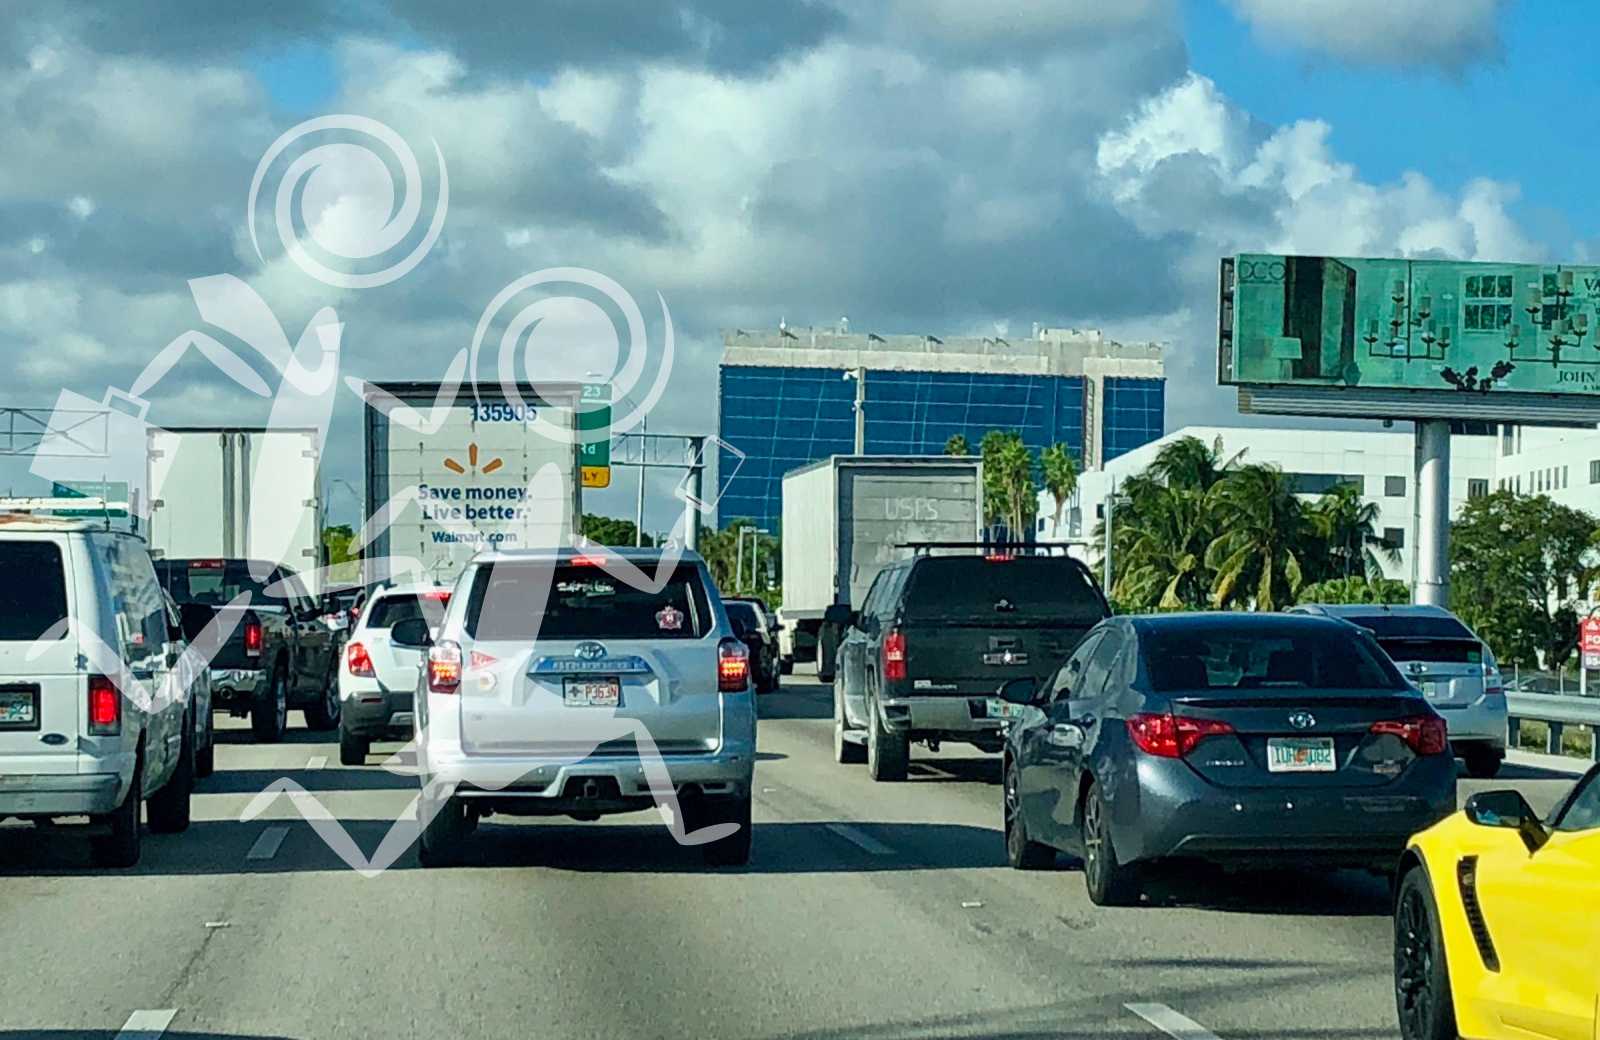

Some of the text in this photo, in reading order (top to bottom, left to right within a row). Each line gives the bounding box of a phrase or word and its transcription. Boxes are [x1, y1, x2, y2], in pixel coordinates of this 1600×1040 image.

[1556, 371, 1595, 383] JOHN
[583, 385, 600, 397] 23
[471, 403, 537, 421] 135905
[418, 484, 532, 502] Save money.
[422, 504, 461, 519] Live
